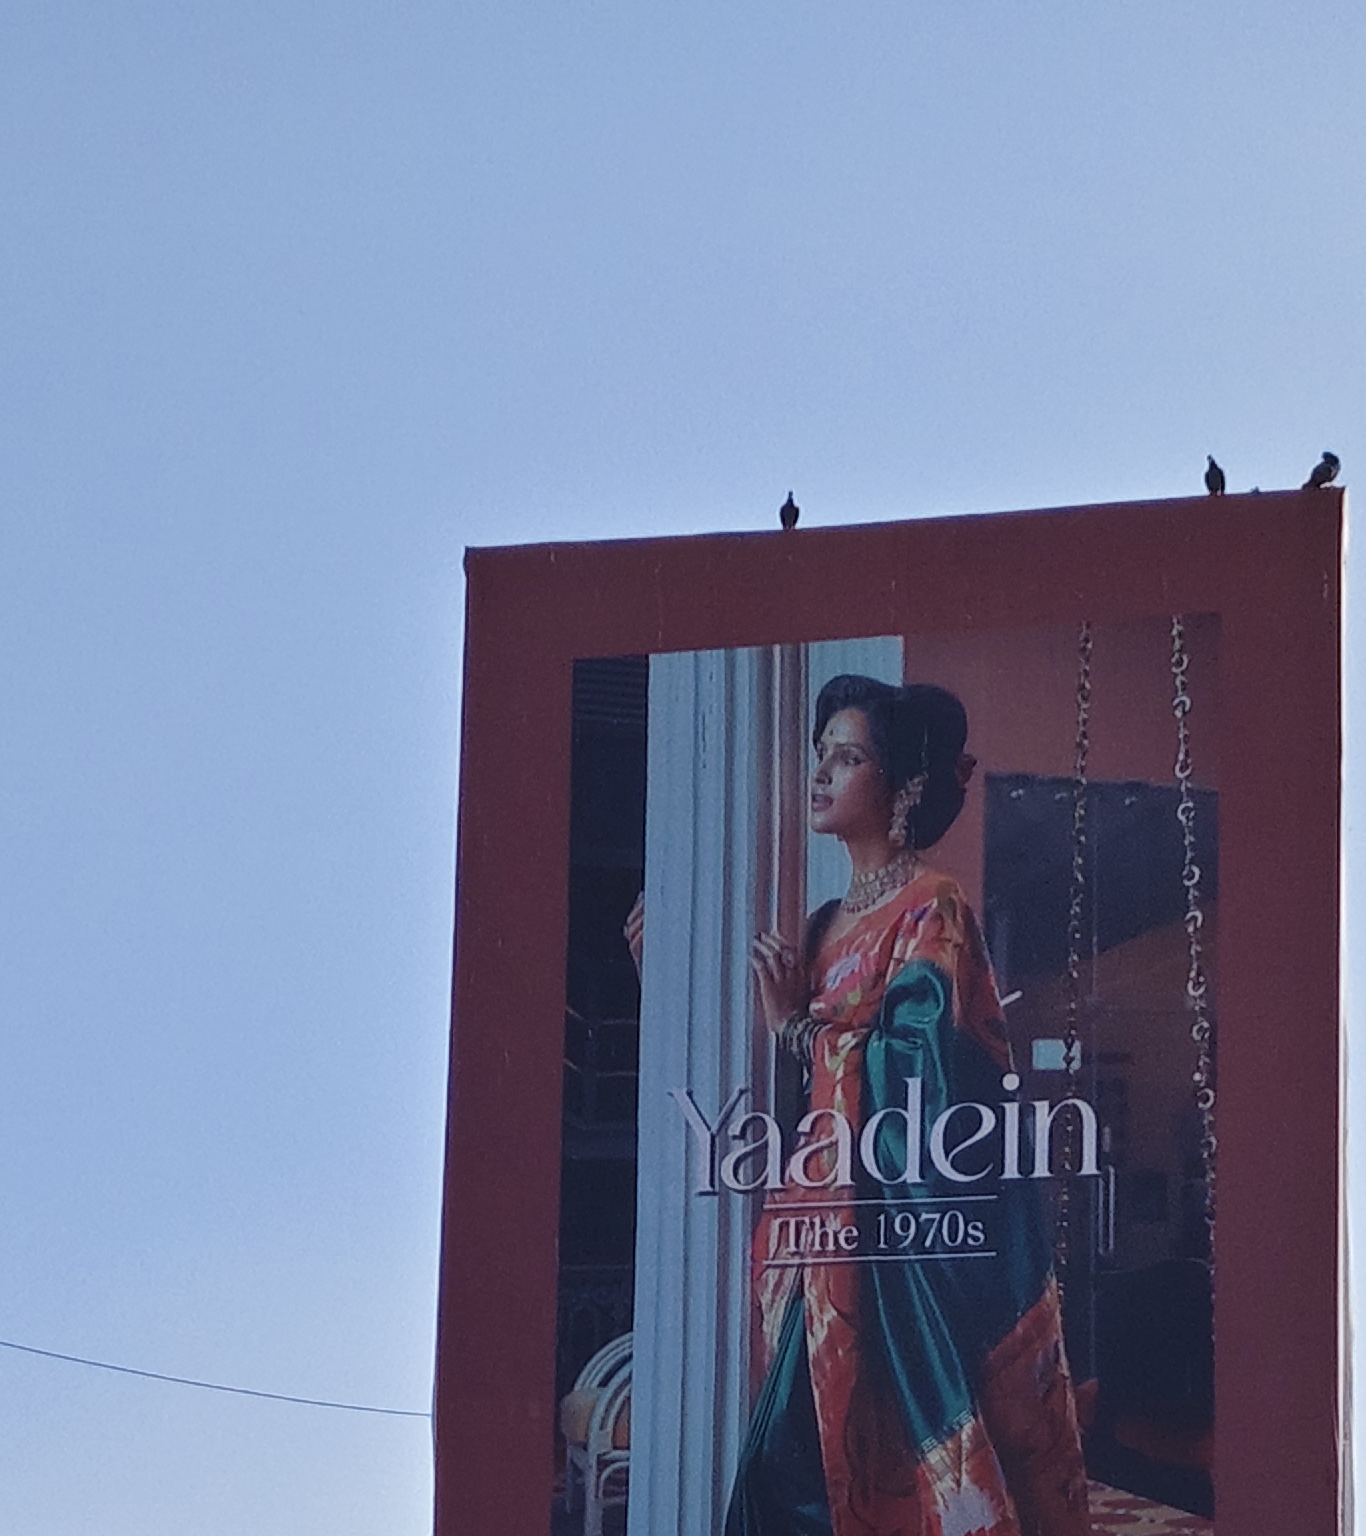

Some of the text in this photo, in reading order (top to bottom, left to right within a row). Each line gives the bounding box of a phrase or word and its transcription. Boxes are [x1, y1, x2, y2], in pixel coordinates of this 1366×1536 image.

[668, 1074, 1101, 1196] Yaadein
[784, 1209, 985, 1254] The 1970s
